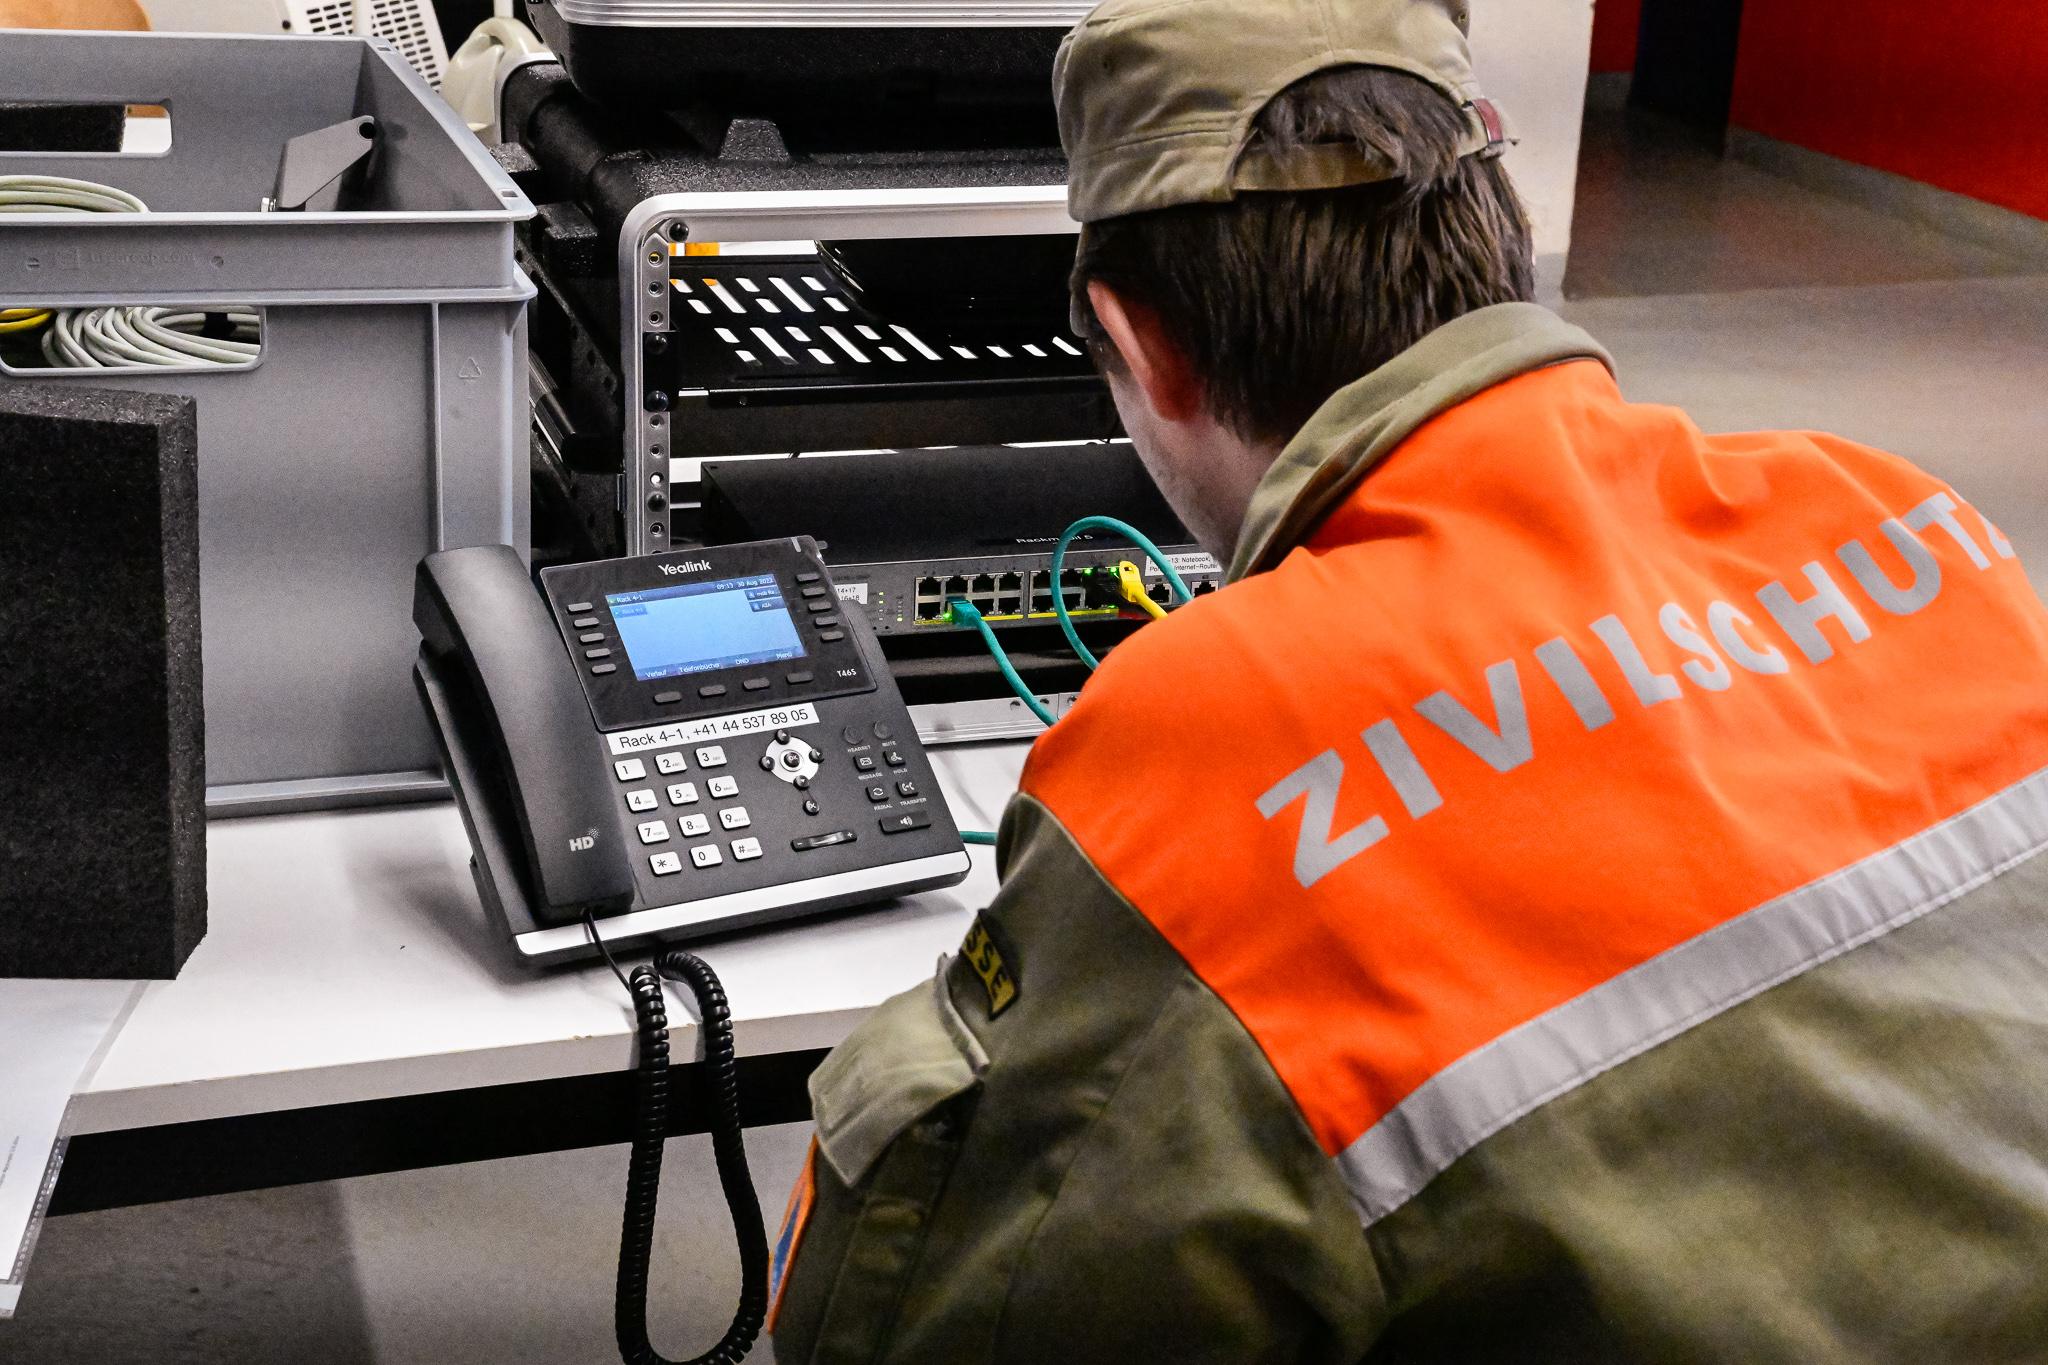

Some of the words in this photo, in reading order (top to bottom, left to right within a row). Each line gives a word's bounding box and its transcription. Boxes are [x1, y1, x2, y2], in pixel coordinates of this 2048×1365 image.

[658, 559, 712, 576] Yealink
[645, 668, 667, 678] Verlauf
[735, 657, 750, 665] DND
[775, 651, 793, 660] Menü
[836, 668, 857, 678] T46S
[619, 732, 656, 749] Rack
[693, 723, 718, 737] +41
[722, 720, 740, 733] 44
[743, 715, 767, 730] 537
[771, 711, 789, 725] 89
[791, 708, 809, 722] 05
[702, 752, 711, 762] 3
[662, 758, 672, 768] 2
[621, 765, 630, 775] 1
[714, 782, 723, 792] 6
[674, 789, 683, 799] 5
[633, 796, 642, 806] 4
[724, 813, 733, 823] 9
[685, 820, 695, 831] 8
[644, 827, 652, 837] 7
[568, 835, 595, 852] HD
[697, 851, 707, 862] 0
